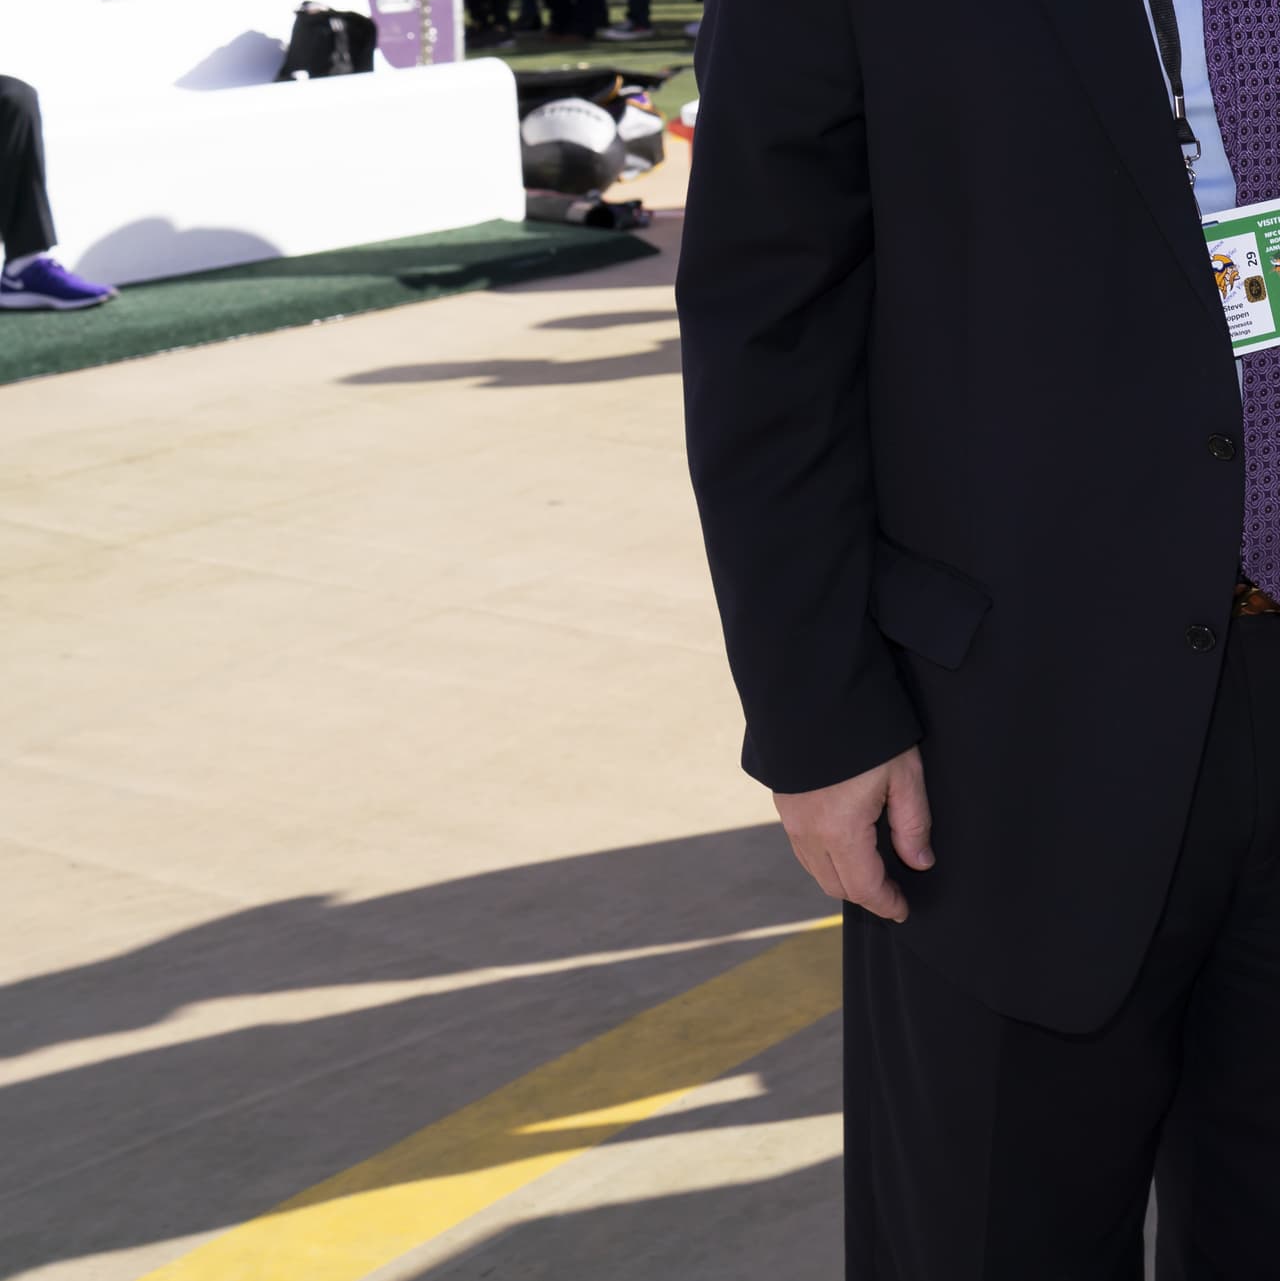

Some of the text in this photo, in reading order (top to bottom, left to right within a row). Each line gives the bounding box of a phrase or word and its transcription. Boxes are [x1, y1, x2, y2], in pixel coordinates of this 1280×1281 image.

[1264, 230, 1277, 238] NFC
[1246, 251, 1258, 267] 29
[1223, 303, 1244, 313] Steve
[1226, 311, 1250, 322] oppen
